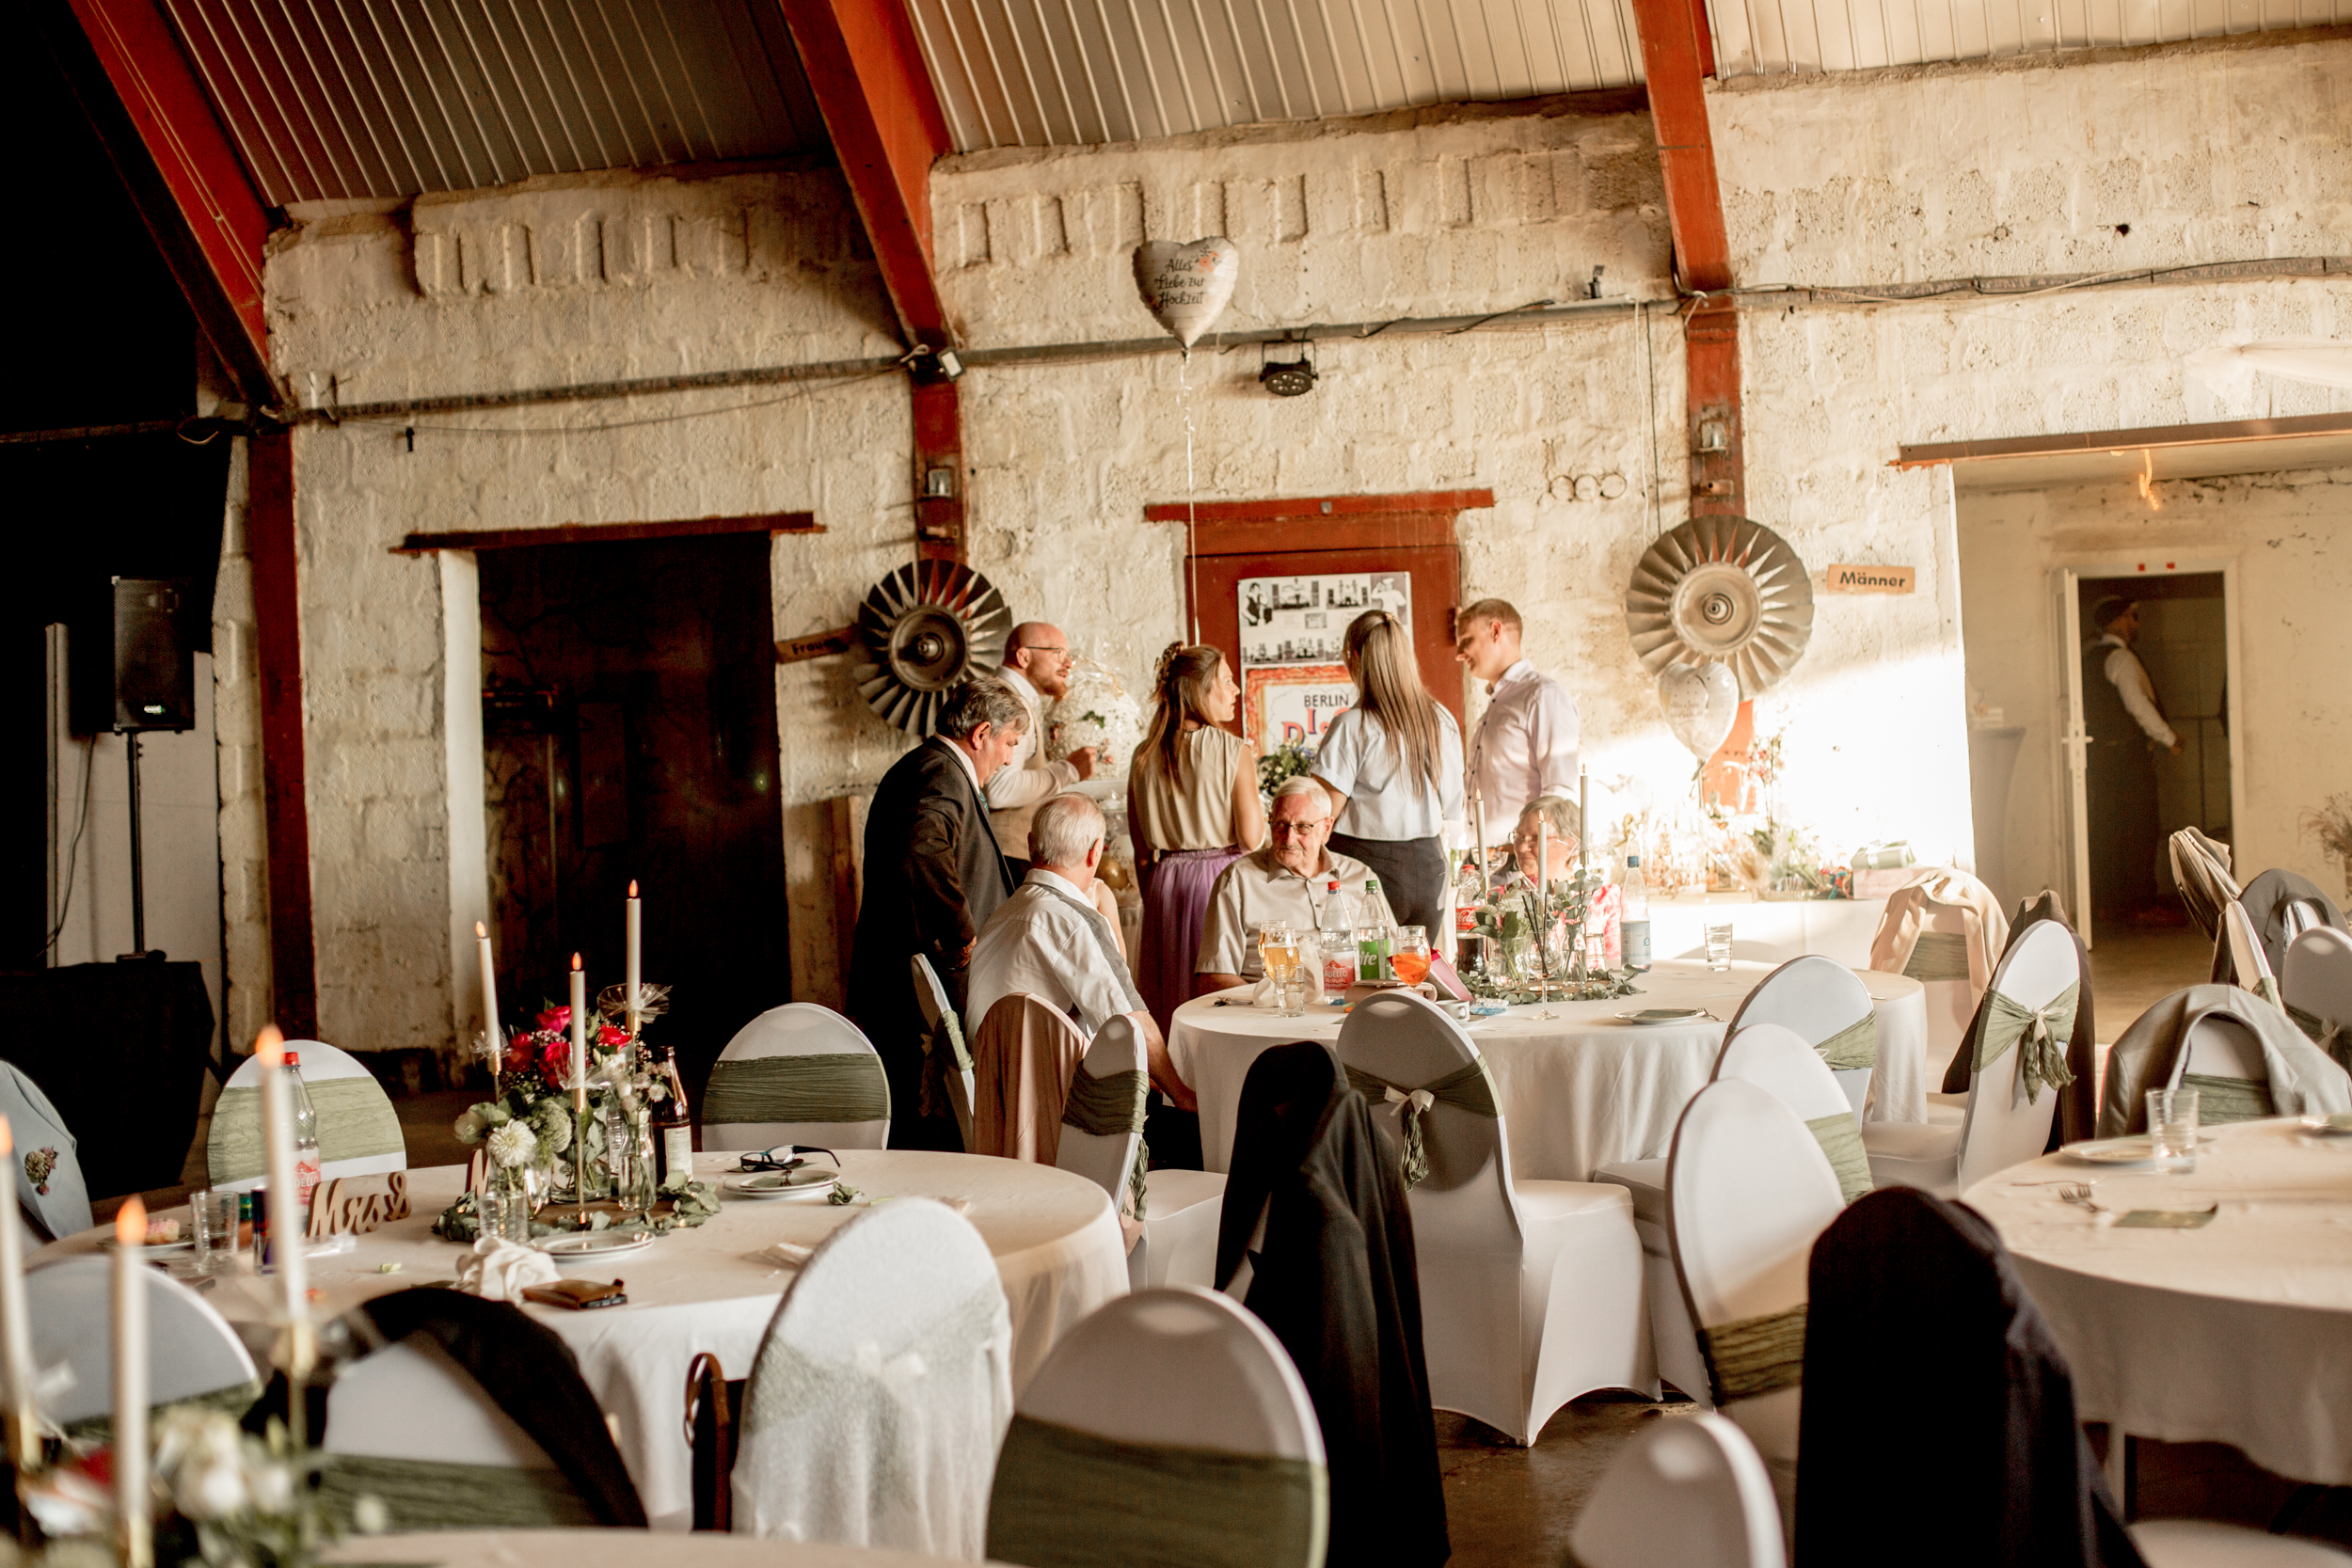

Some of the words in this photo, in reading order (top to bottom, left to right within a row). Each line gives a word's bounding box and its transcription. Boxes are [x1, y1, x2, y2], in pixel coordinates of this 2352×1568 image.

[1167, 259, 1194, 273] Alles
[1154, 274, 1185, 290] Liebe
[1188, 277, 1205, 288] zur
[1156, 292, 1205, 309] Hochzeit
[1839, 571, 1906, 587] Männer
[1304, 694, 1349, 707] BERLIN
[1359, 950, 1378, 966] ite
[1324, 970, 1348, 979] ADELLO
[293, 1176, 319, 1188] DELLO
[383, 1171, 413, 1223] &
